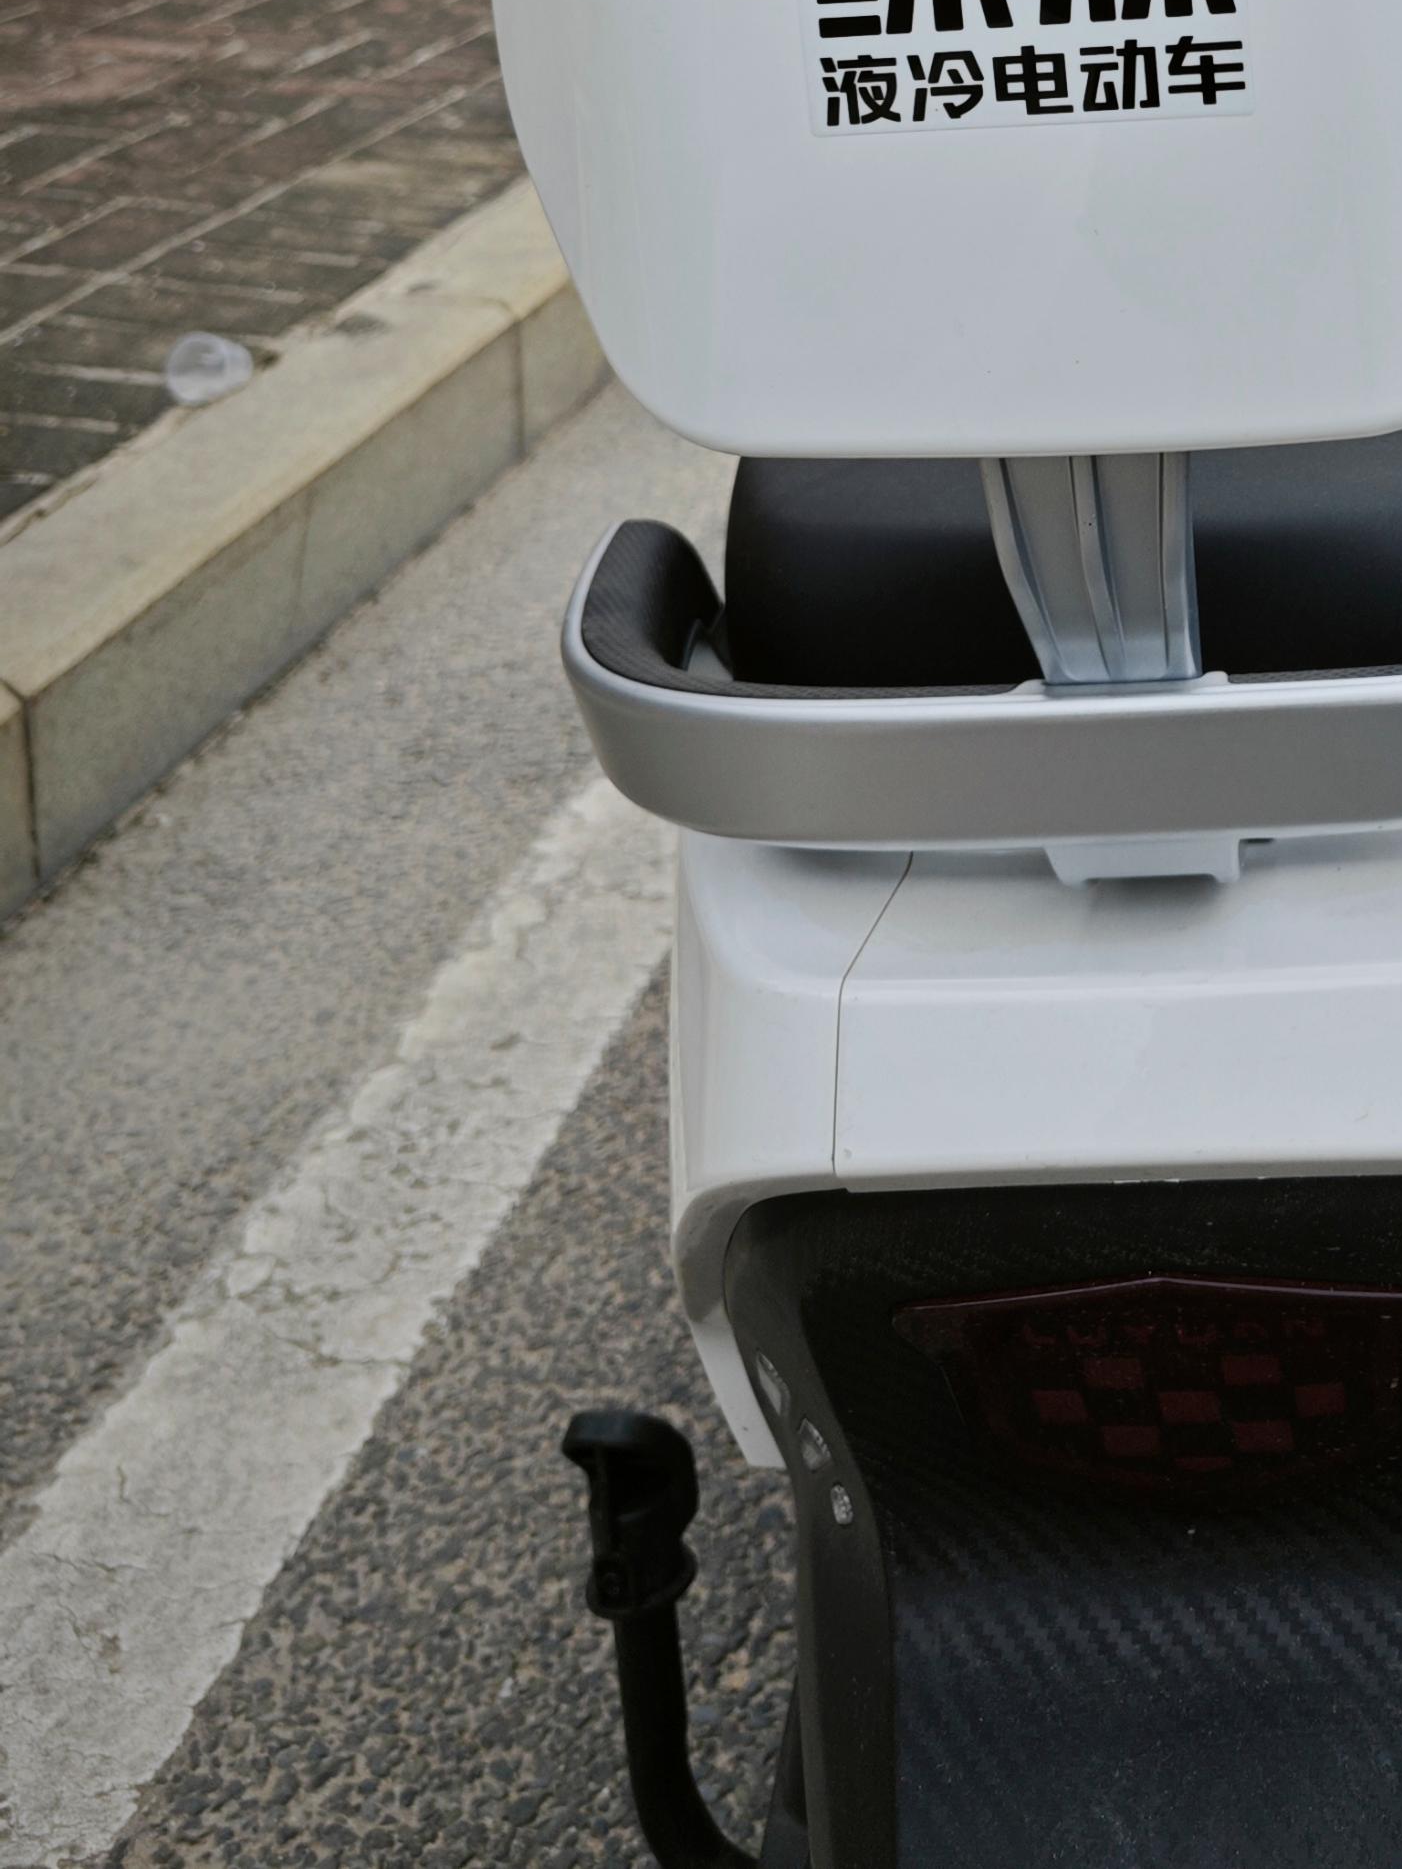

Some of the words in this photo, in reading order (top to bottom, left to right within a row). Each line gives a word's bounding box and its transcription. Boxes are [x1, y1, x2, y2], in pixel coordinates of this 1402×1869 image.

[820, 36, 1246, 126] 液冷电动车
